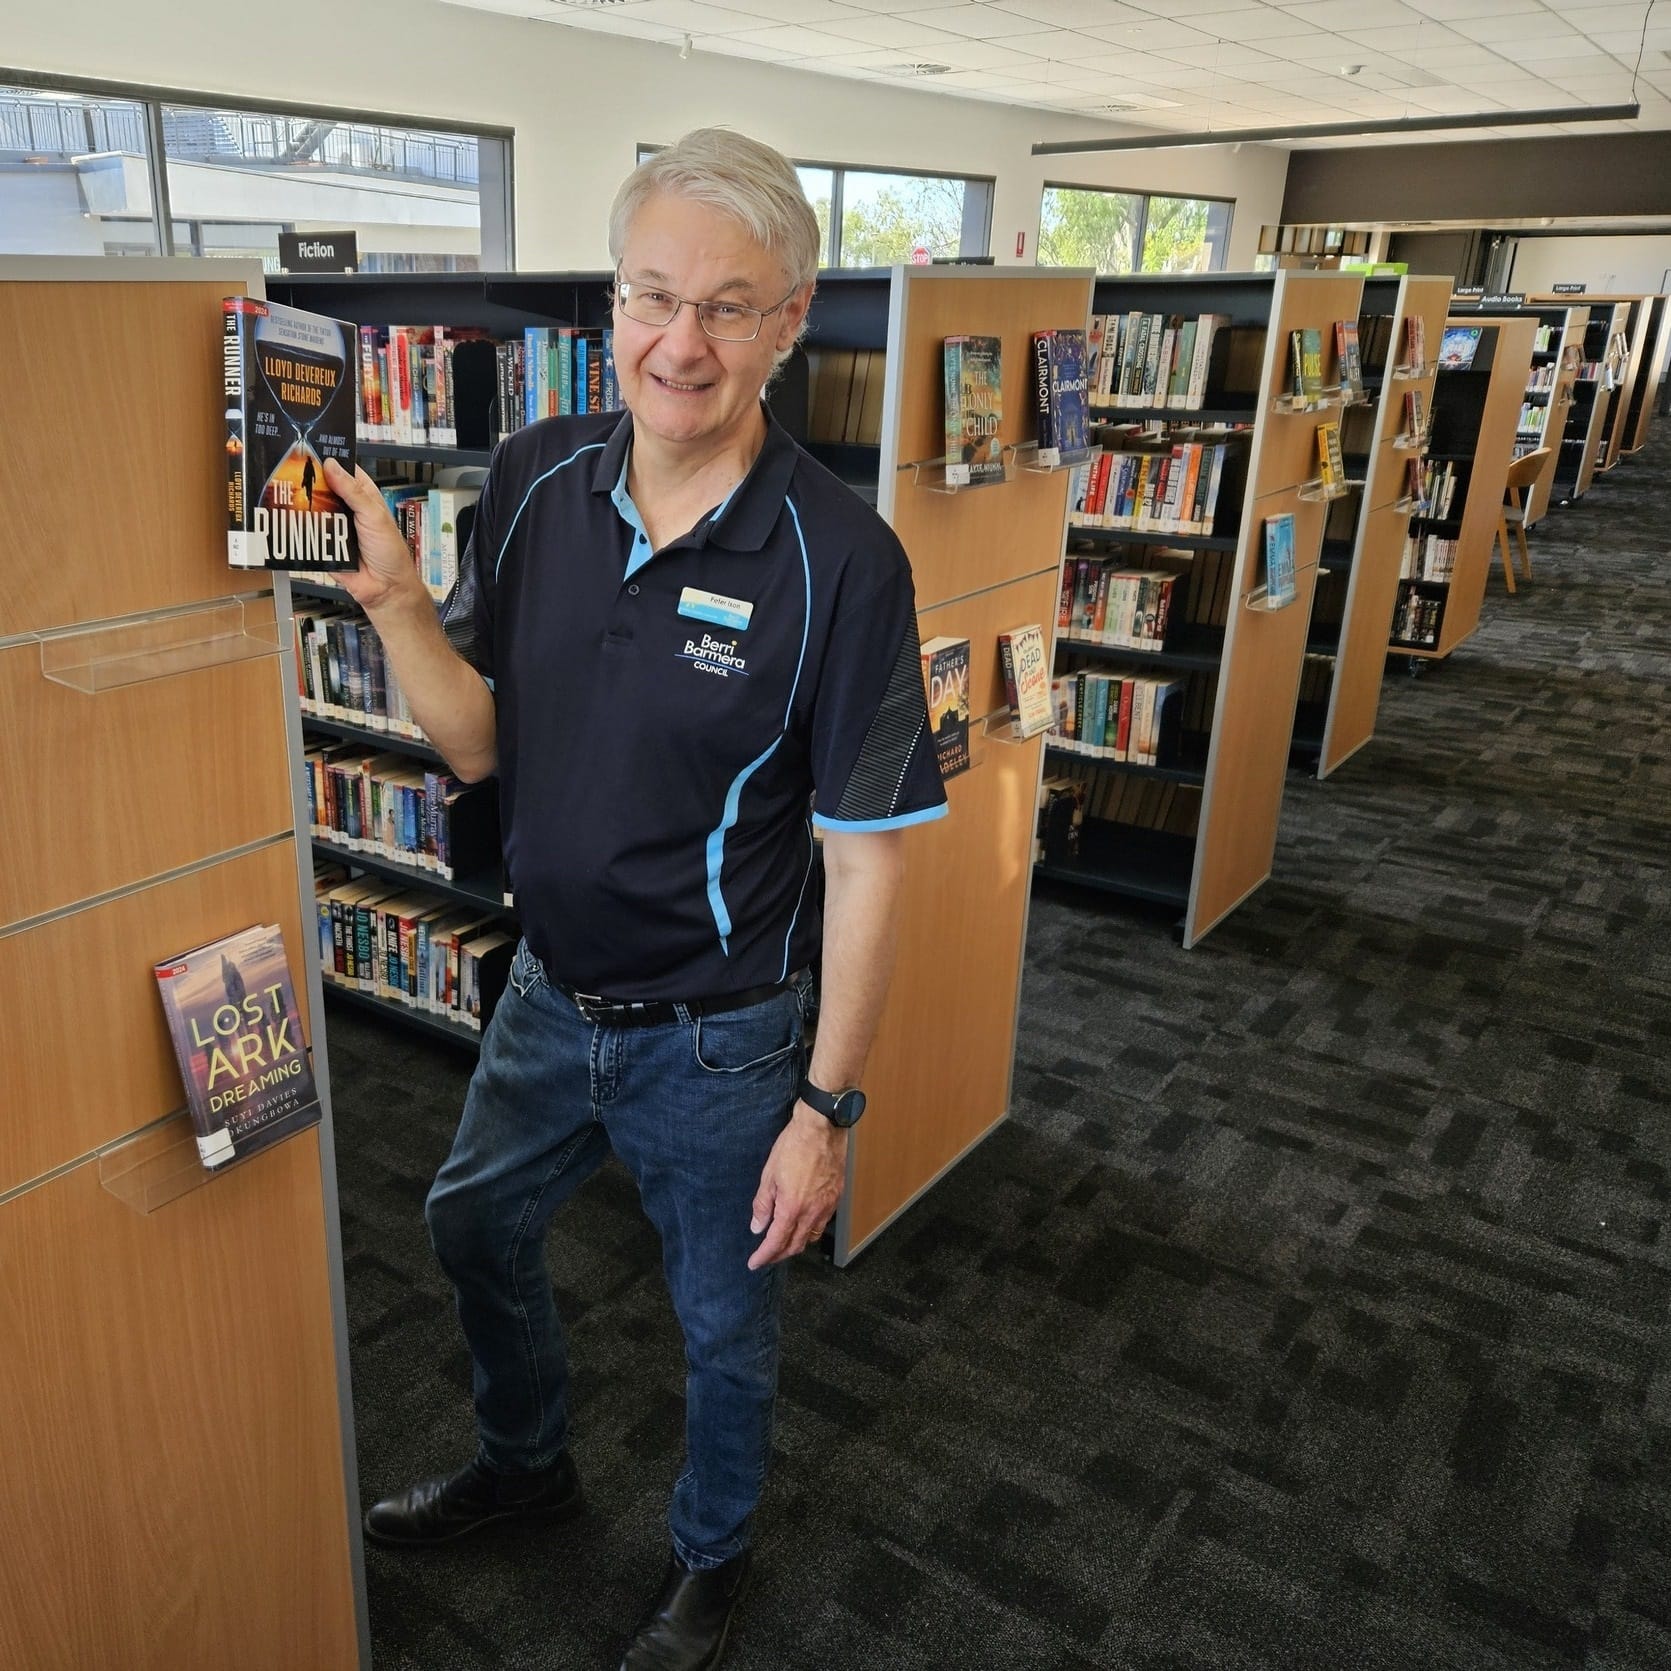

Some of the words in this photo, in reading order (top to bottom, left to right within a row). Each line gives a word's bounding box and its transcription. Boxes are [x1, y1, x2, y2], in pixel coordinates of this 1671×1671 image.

[298, 242, 334, 258] Fiction
[255, 306, 267, 316] 2024
[226, 314, 236, 331] THE
[224, 335, 240, 396] RUNNER
[362, 344, 372, 381] FURY
[1136, 343, 1145, 368] CROSSING
[265, 356, 292, 378] LLOYD
[296, 364, 336, 387] DEVEREUX
[590, 362, 600, 392] VINE
[975, 371, 987, 385] THE
[1037, 340, 1049, 414] CLAIRMONT
[281, 382, 321, 406] RICHARDS
[1052, 379, 1088, 392] CLAIRMONT
[969, 392, 993, 409] ONLY
[257, 412, 269, 423] HE'S
[270, 414, 275, 423] IN
[966, 416, 998, 436] CHILD
[256, 424, 265, 434] TOO
[329, 435, 346, 445] ALMOST
[323, 446, 331, 456] OUT
[332, 447, 338, 457] OF
[339, 448, 350, 458] TIME
[970, 464, 983, 473] AYTE
[271, 479, 294, 505] THE
[409, 505, 414, 517] NO
[254, 507, 350, 562] RUNNER
[710, 597, 726, 605] Peter
[684, 640, 745, 669] Barmera
[701, 634, 737, 655] Berri
[694, 661, 728, 677] COUNCIL
[935, 655, 964, 673] FATHER'S
[1003, 647, 1012, 669] DEAD
[1020, 648, 1041, 671] DEAD
[931, 664, 967, 709] DAY
[1021, 667, 1044, 695] Scone
[430, 805, 438, 836] Murray
[357, 908, 368, 922] JO
[399, 922, 408, 934] JO
[357, 924, 369, 959] NESBO
[388, 930, 397, 953] KNIFE
[400, 935, 409, 962] NESBO
[172, 966, 186, 975] 2024
[388, 955, 397, 964] JO
[389, 965, 398, 987] NESBO
[191, 982, 282, 1047] LOST
[208, 1017, 296, 1090] ARK
[210, 1059, 301, 1113] DREAMING
[224, 1109, 252, 1127] SUYI
[257, 1088, 297, 1112] DAVIES
